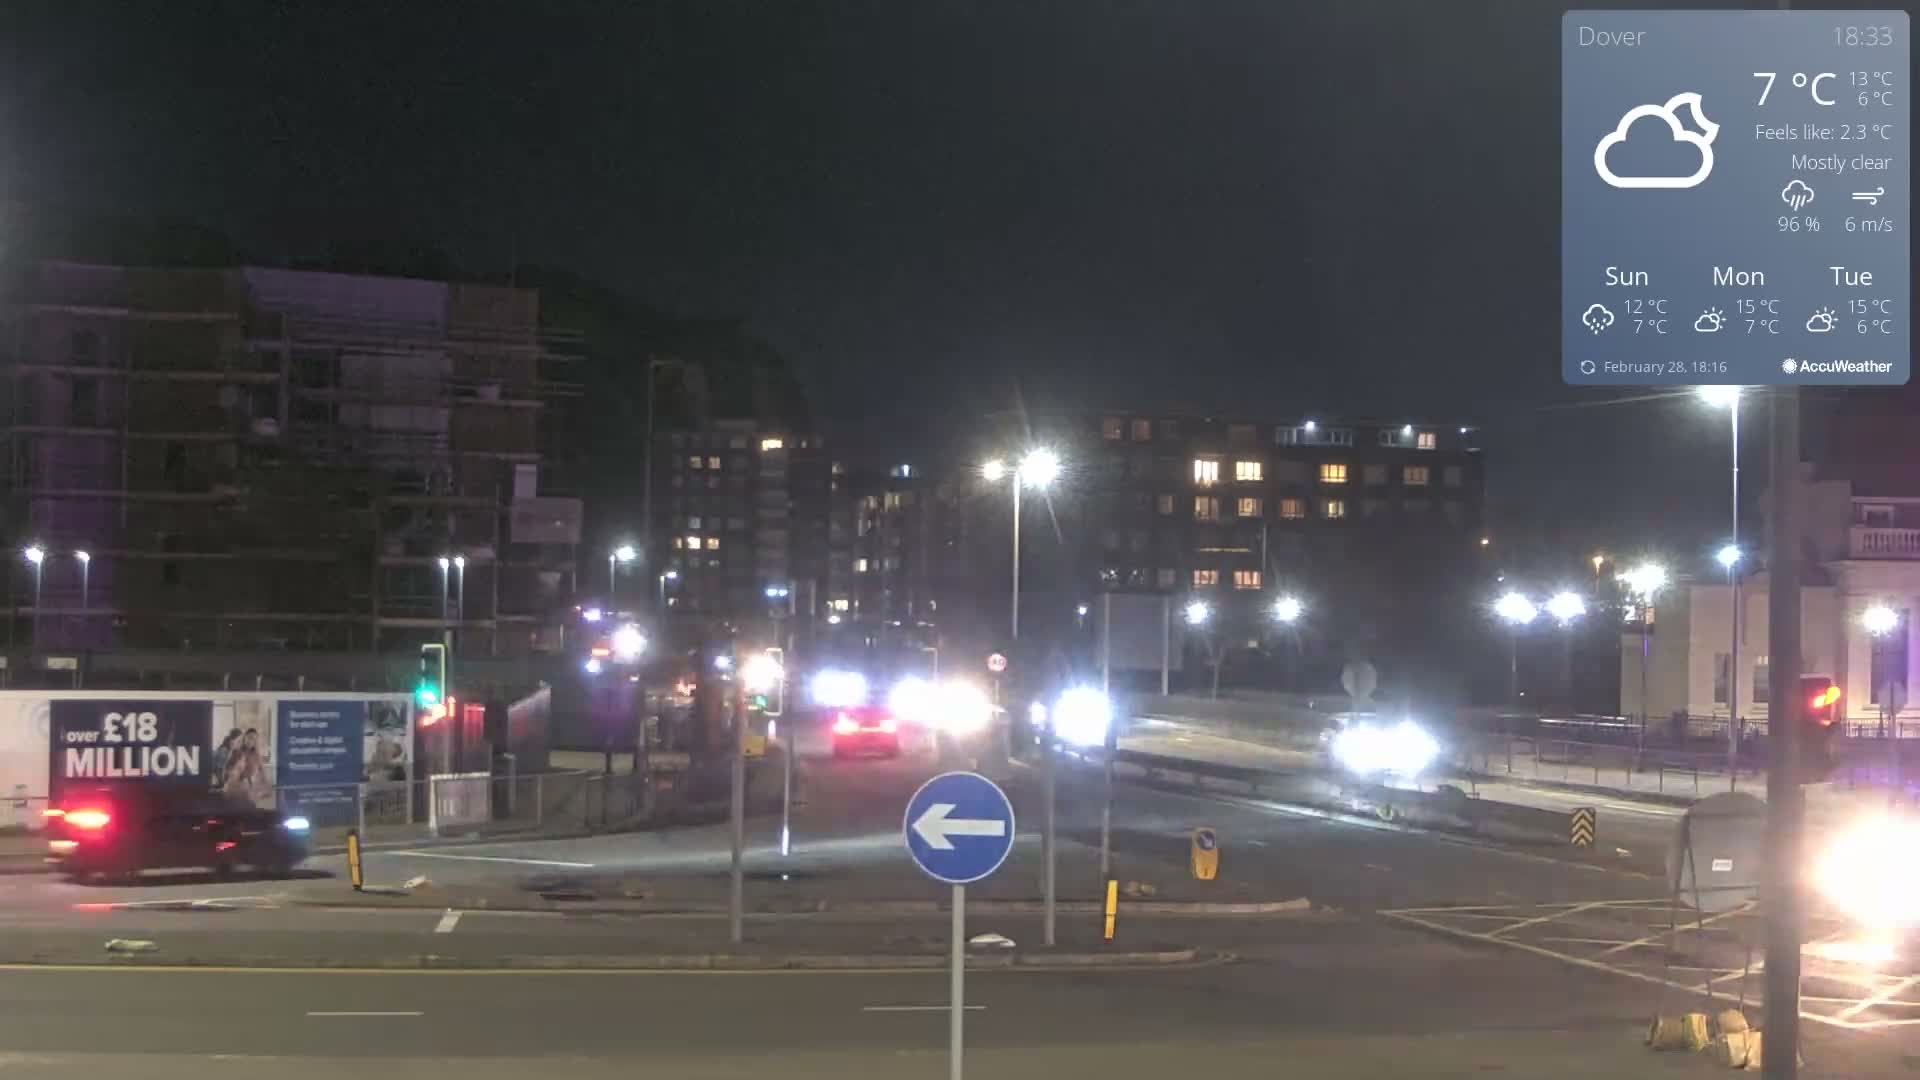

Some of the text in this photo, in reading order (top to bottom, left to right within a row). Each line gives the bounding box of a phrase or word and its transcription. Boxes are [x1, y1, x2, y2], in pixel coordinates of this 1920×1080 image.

[66, 712, 157, 742] over £18
[66, 746, 200, 777] MILLION
